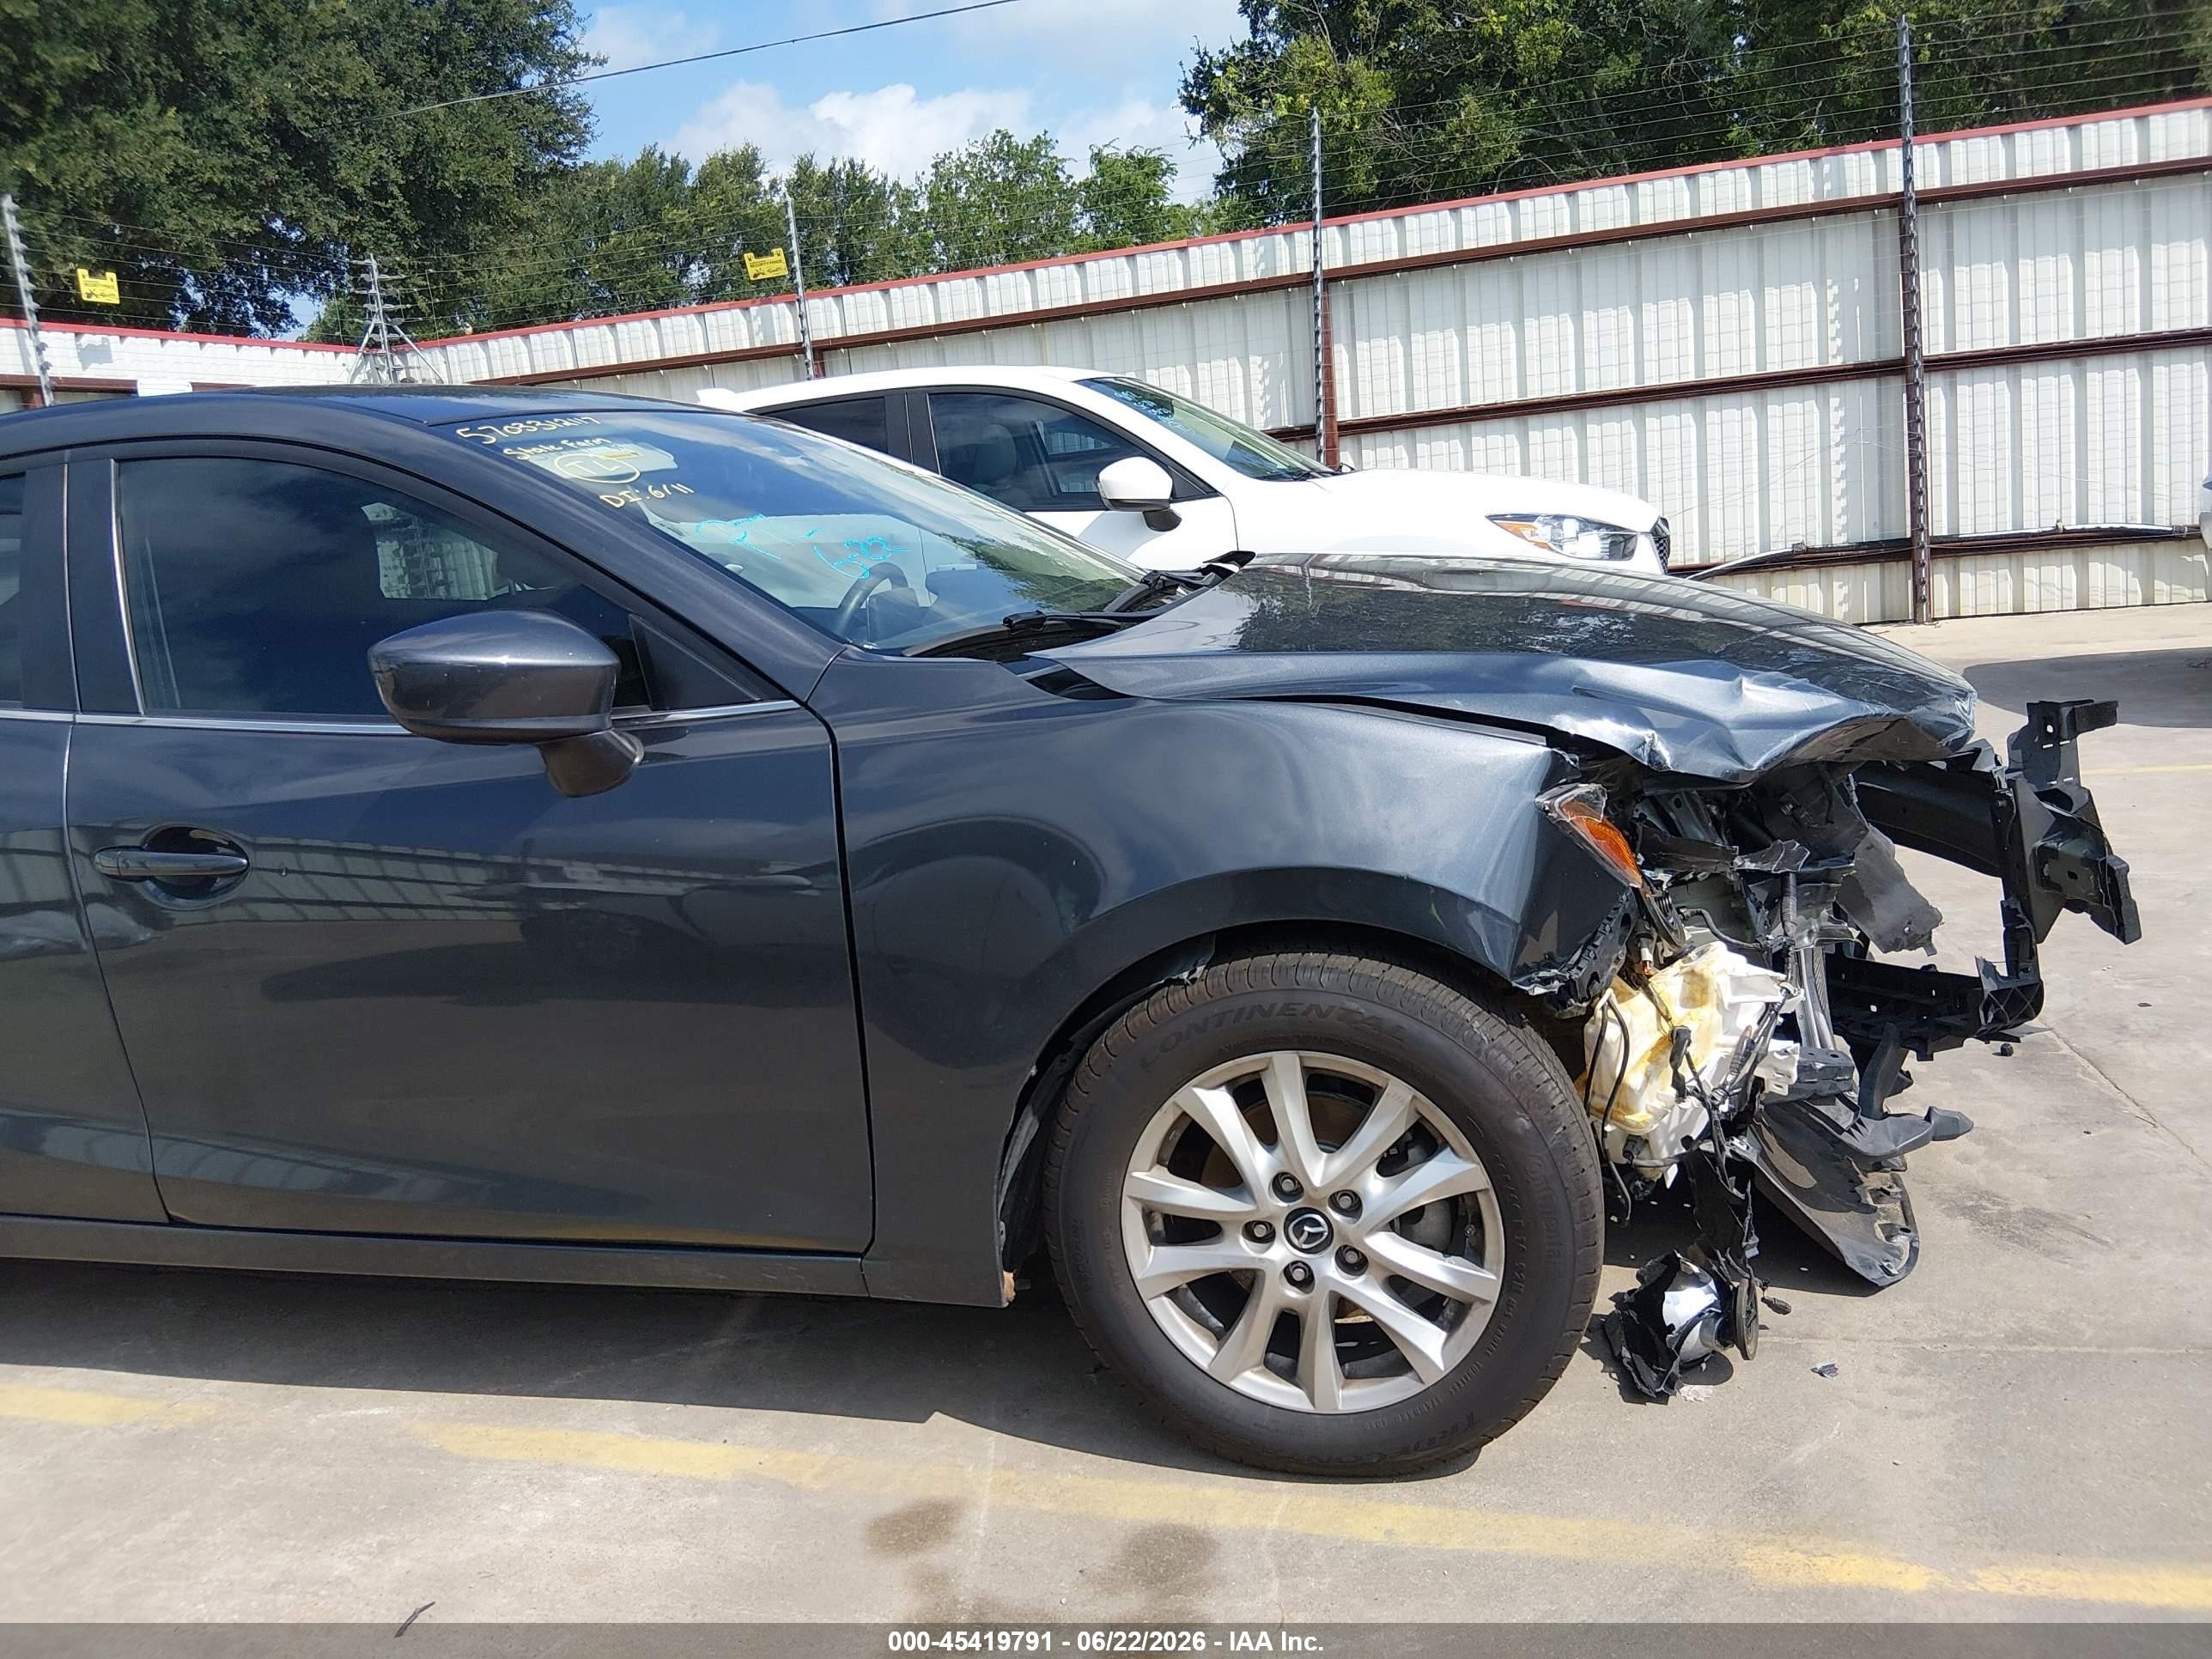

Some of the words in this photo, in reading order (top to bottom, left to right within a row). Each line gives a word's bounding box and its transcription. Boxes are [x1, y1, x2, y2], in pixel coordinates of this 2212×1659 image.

[503, 444, 563, 460] State
[561, 437, 612, 449] Farm
[1139, 1001, 1405, 1071] CONTINENTAL
